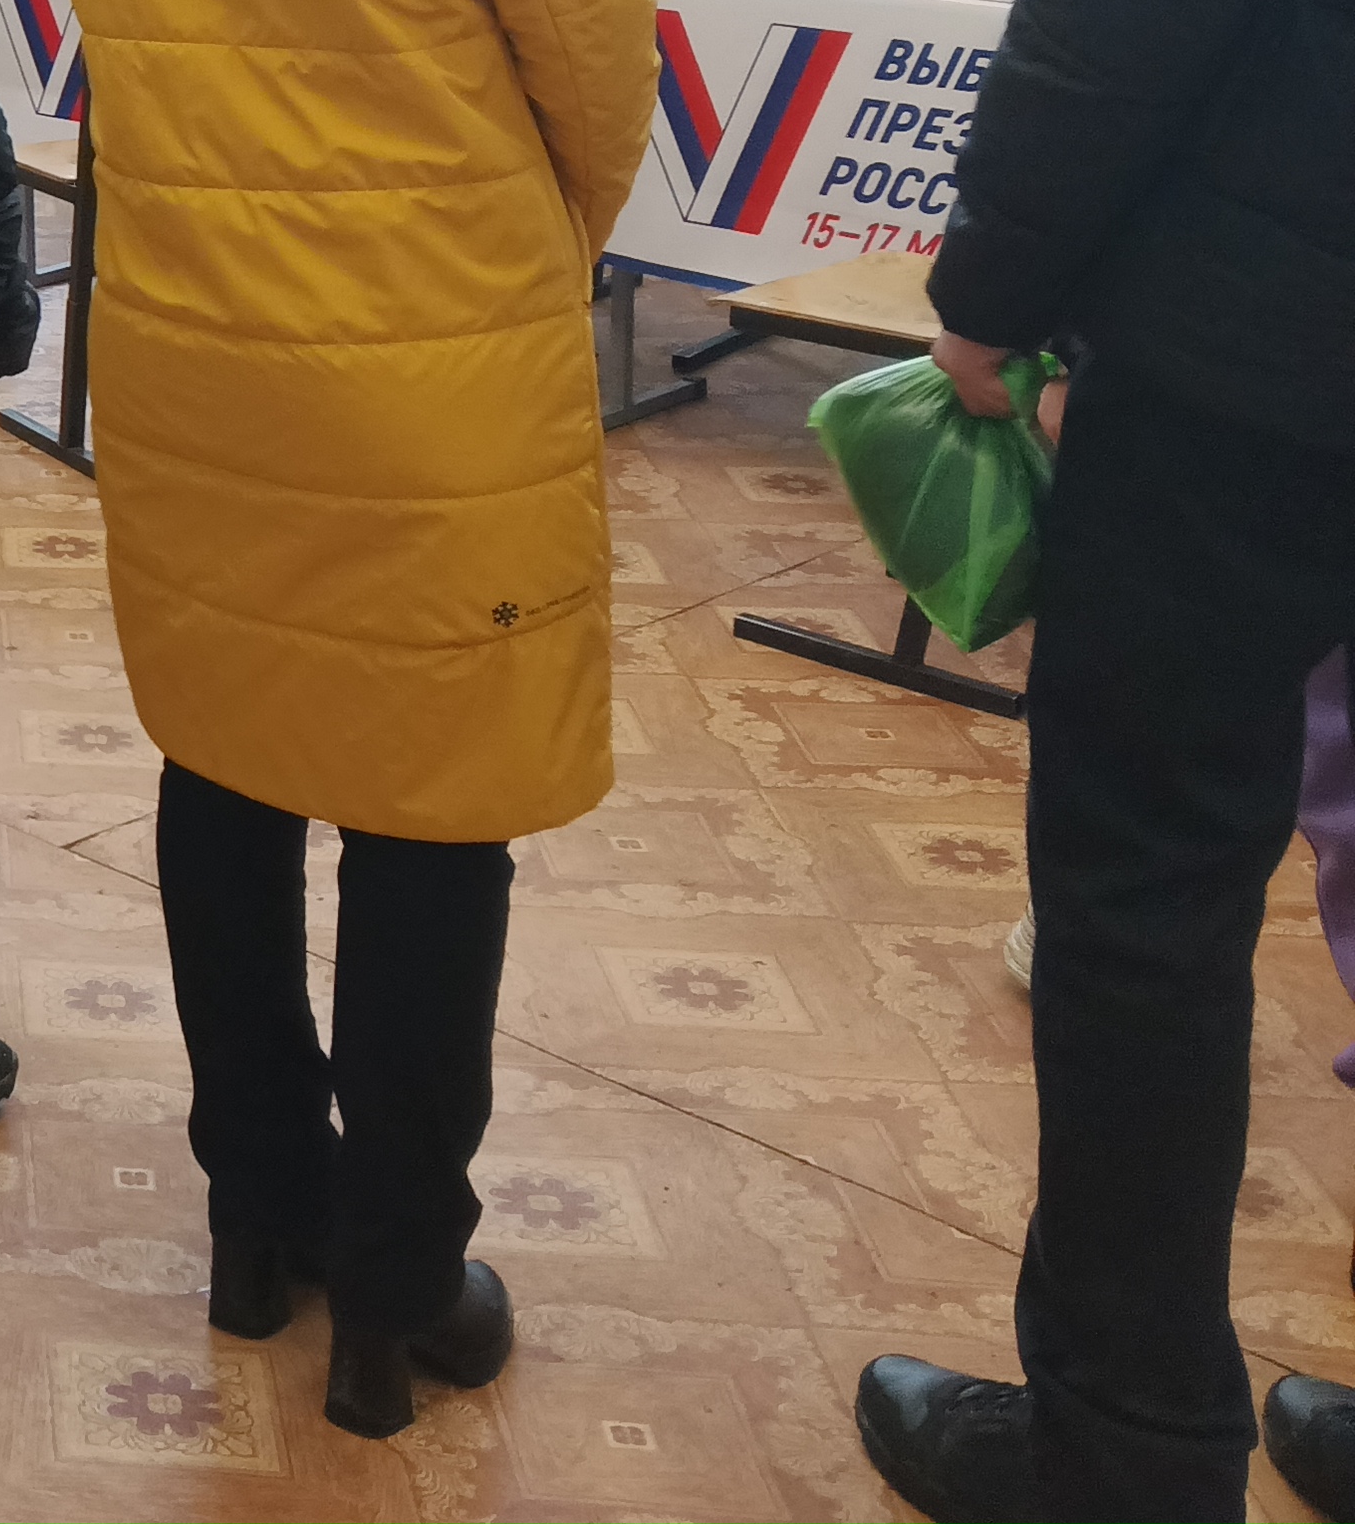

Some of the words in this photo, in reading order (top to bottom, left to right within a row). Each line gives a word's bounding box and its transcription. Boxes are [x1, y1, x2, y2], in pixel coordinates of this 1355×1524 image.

[874, 39, 998, 92] ВЫБ
[845, 98, 976, 155] ПРЕЗ
[818, 156, 960, 214] РОСС
[905, 230, 945, 257] М
